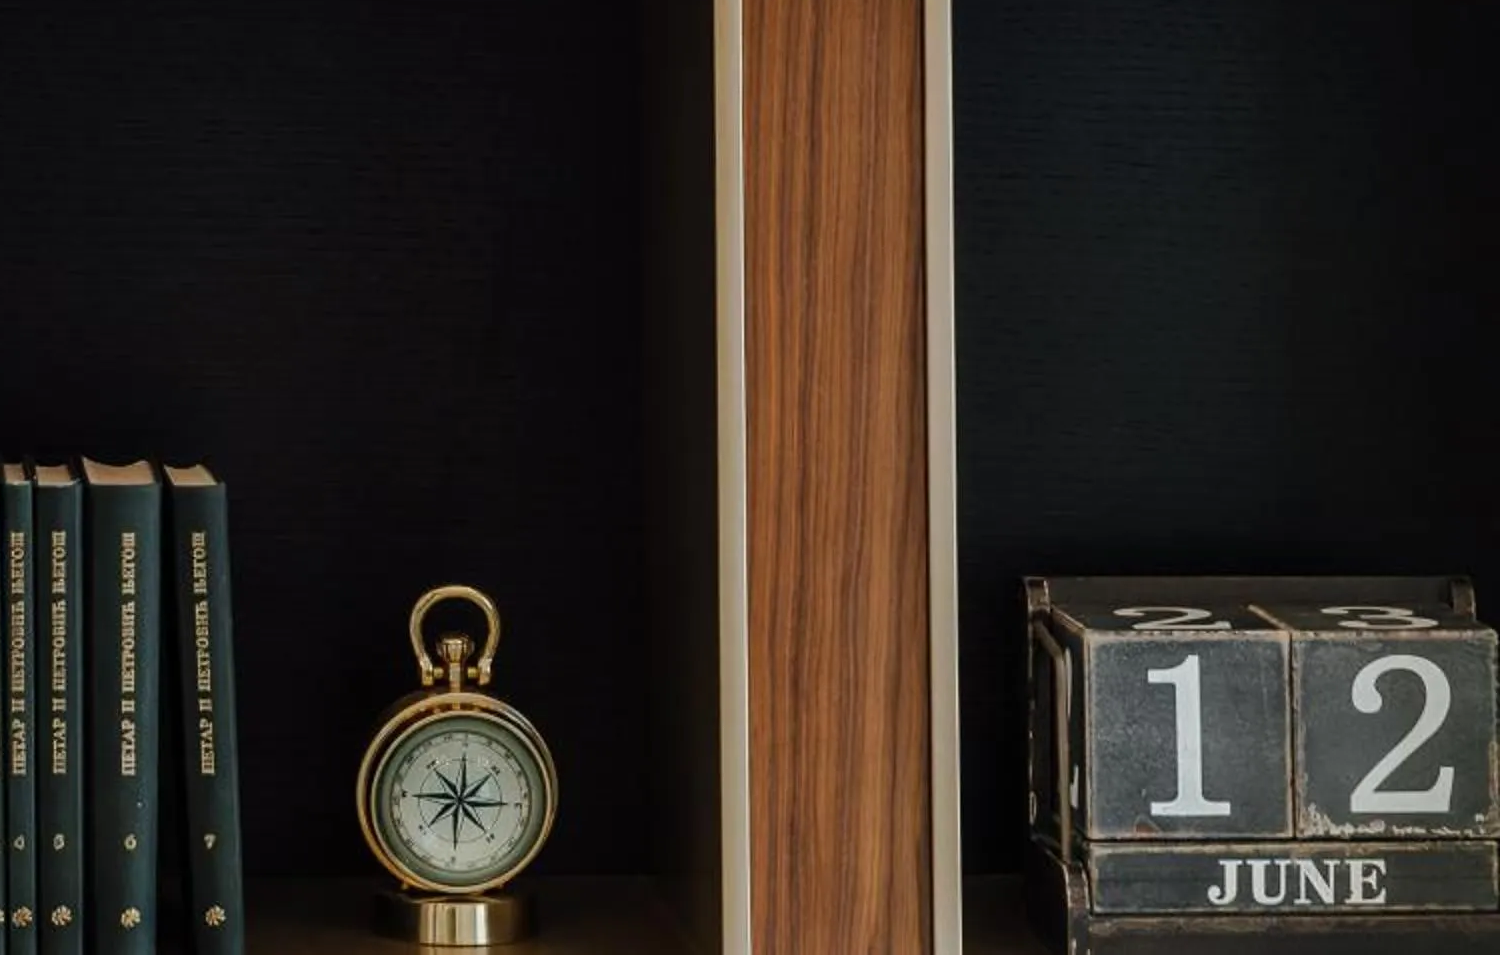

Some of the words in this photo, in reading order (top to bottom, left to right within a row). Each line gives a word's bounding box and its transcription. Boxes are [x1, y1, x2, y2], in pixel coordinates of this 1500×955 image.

[1113, 606, 1233, 630] 2
[1321, 605, 1440, 630] 3
[12, 719, 27, 776] ПЕТАР
[53, 719, 67, 775] ПЕТАР
[121, 719, 136, 776] ПЕТАР
[201, 717, 216, 775] ПЕТАР
[1147, 654, 1231, 816] 1
[1349, 653, 1455, 814] 2
[1207, 858, 1387, 906] JUNE
